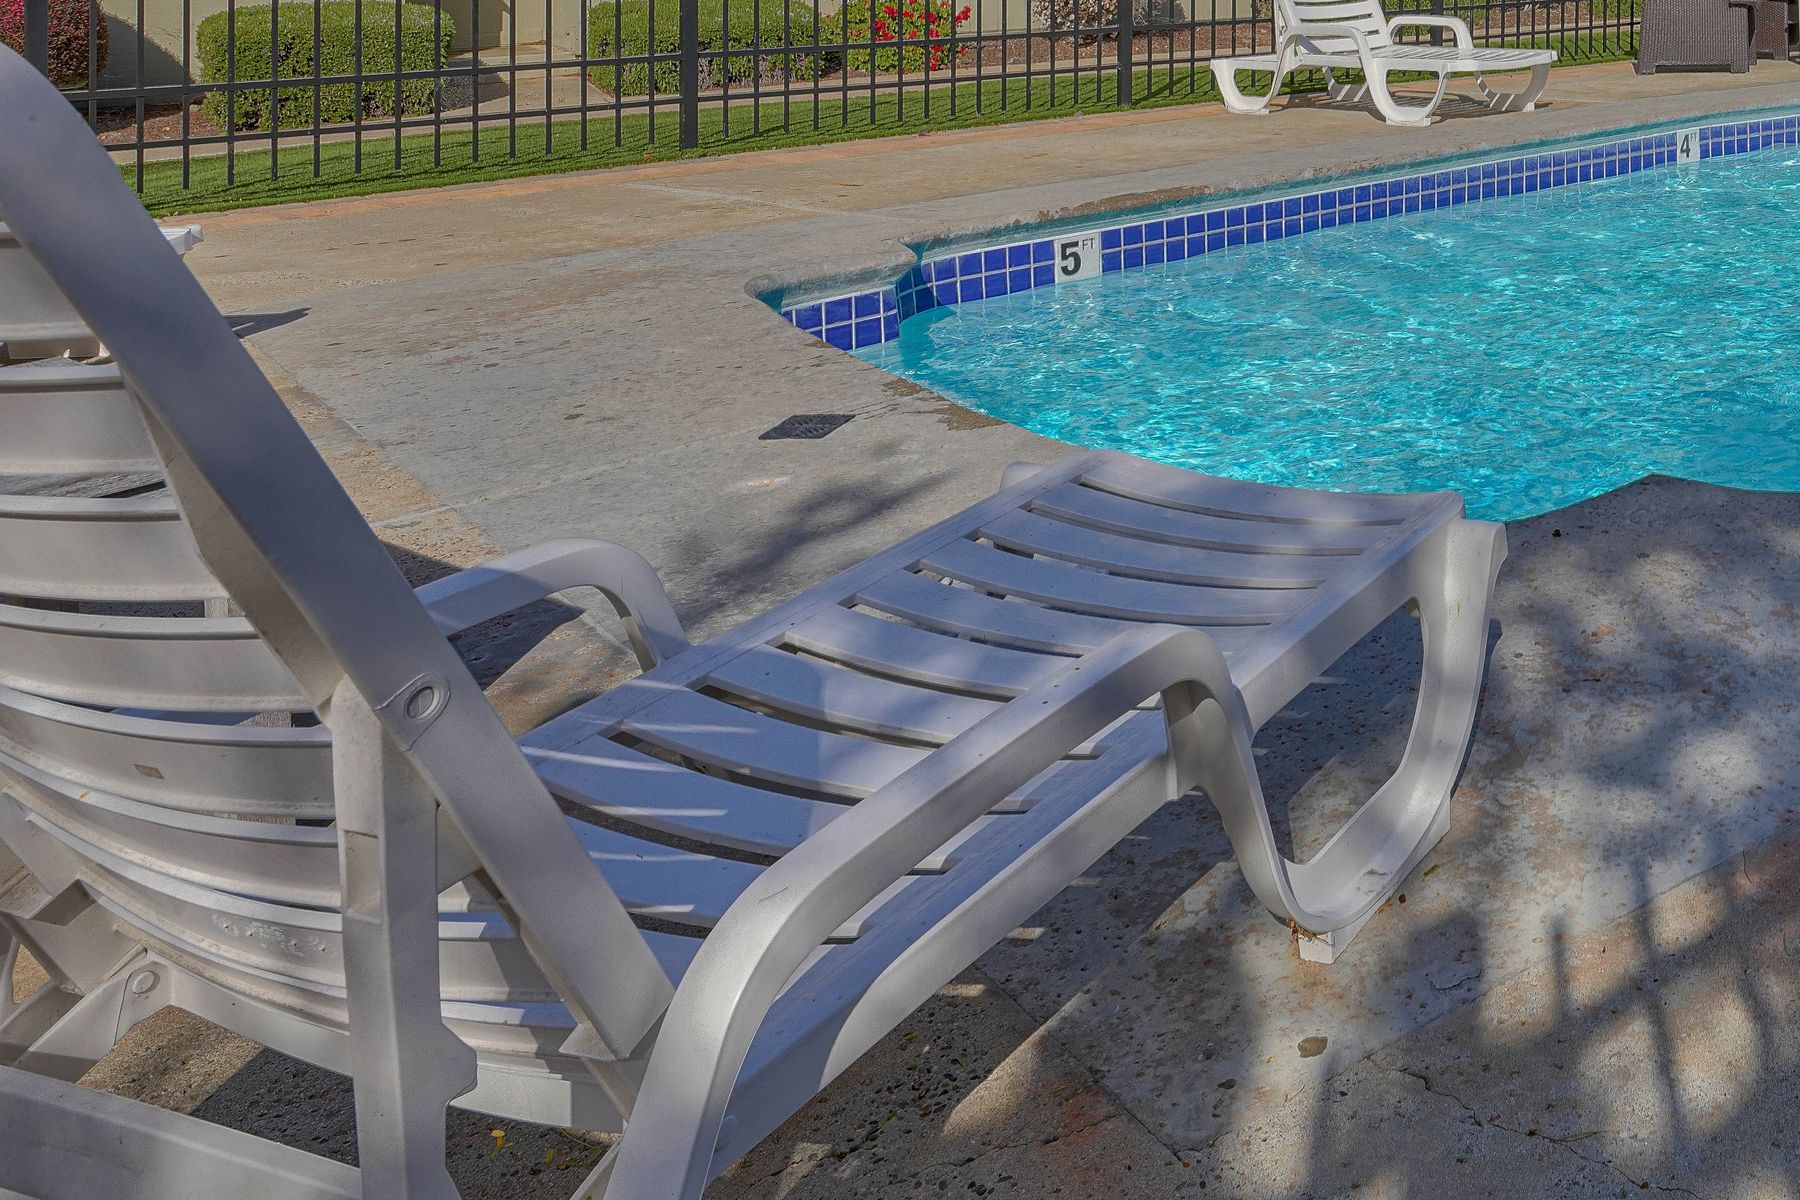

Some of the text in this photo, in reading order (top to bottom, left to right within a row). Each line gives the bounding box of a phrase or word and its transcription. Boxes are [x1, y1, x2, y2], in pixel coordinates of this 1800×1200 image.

[1680, 134, 1691, 158] 4
[1060, 237, 1096, 276] 5 FT
